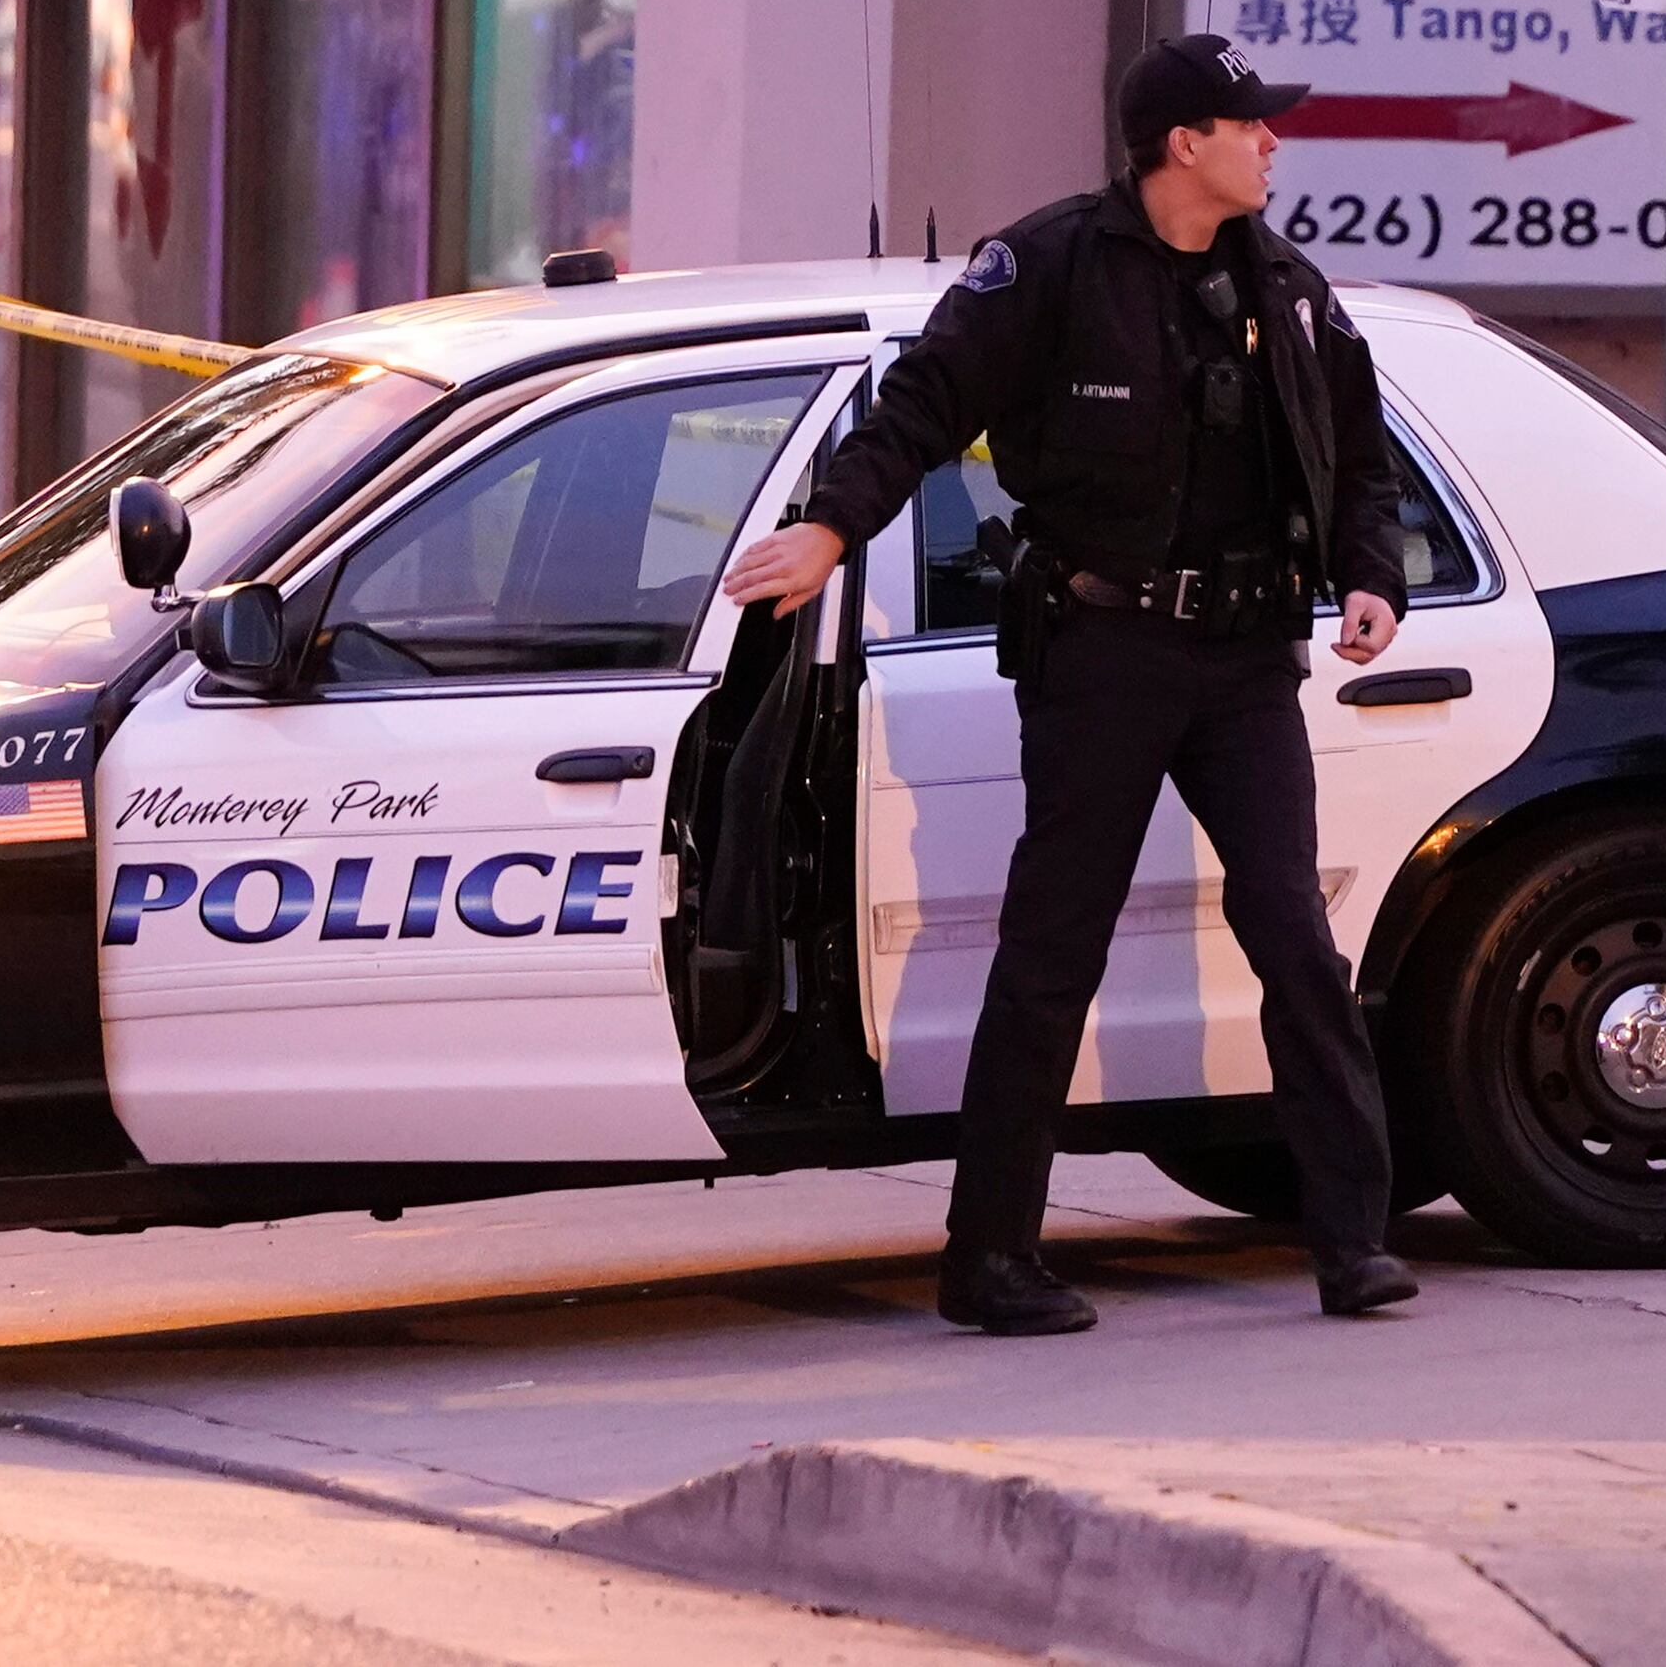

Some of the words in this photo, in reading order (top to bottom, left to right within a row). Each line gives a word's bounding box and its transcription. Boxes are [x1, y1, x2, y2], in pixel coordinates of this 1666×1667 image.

[115, 785, 309, 837] Monterey
[331, 779, 439, 822] Park
[100, 849, 644, 947] POLICE
